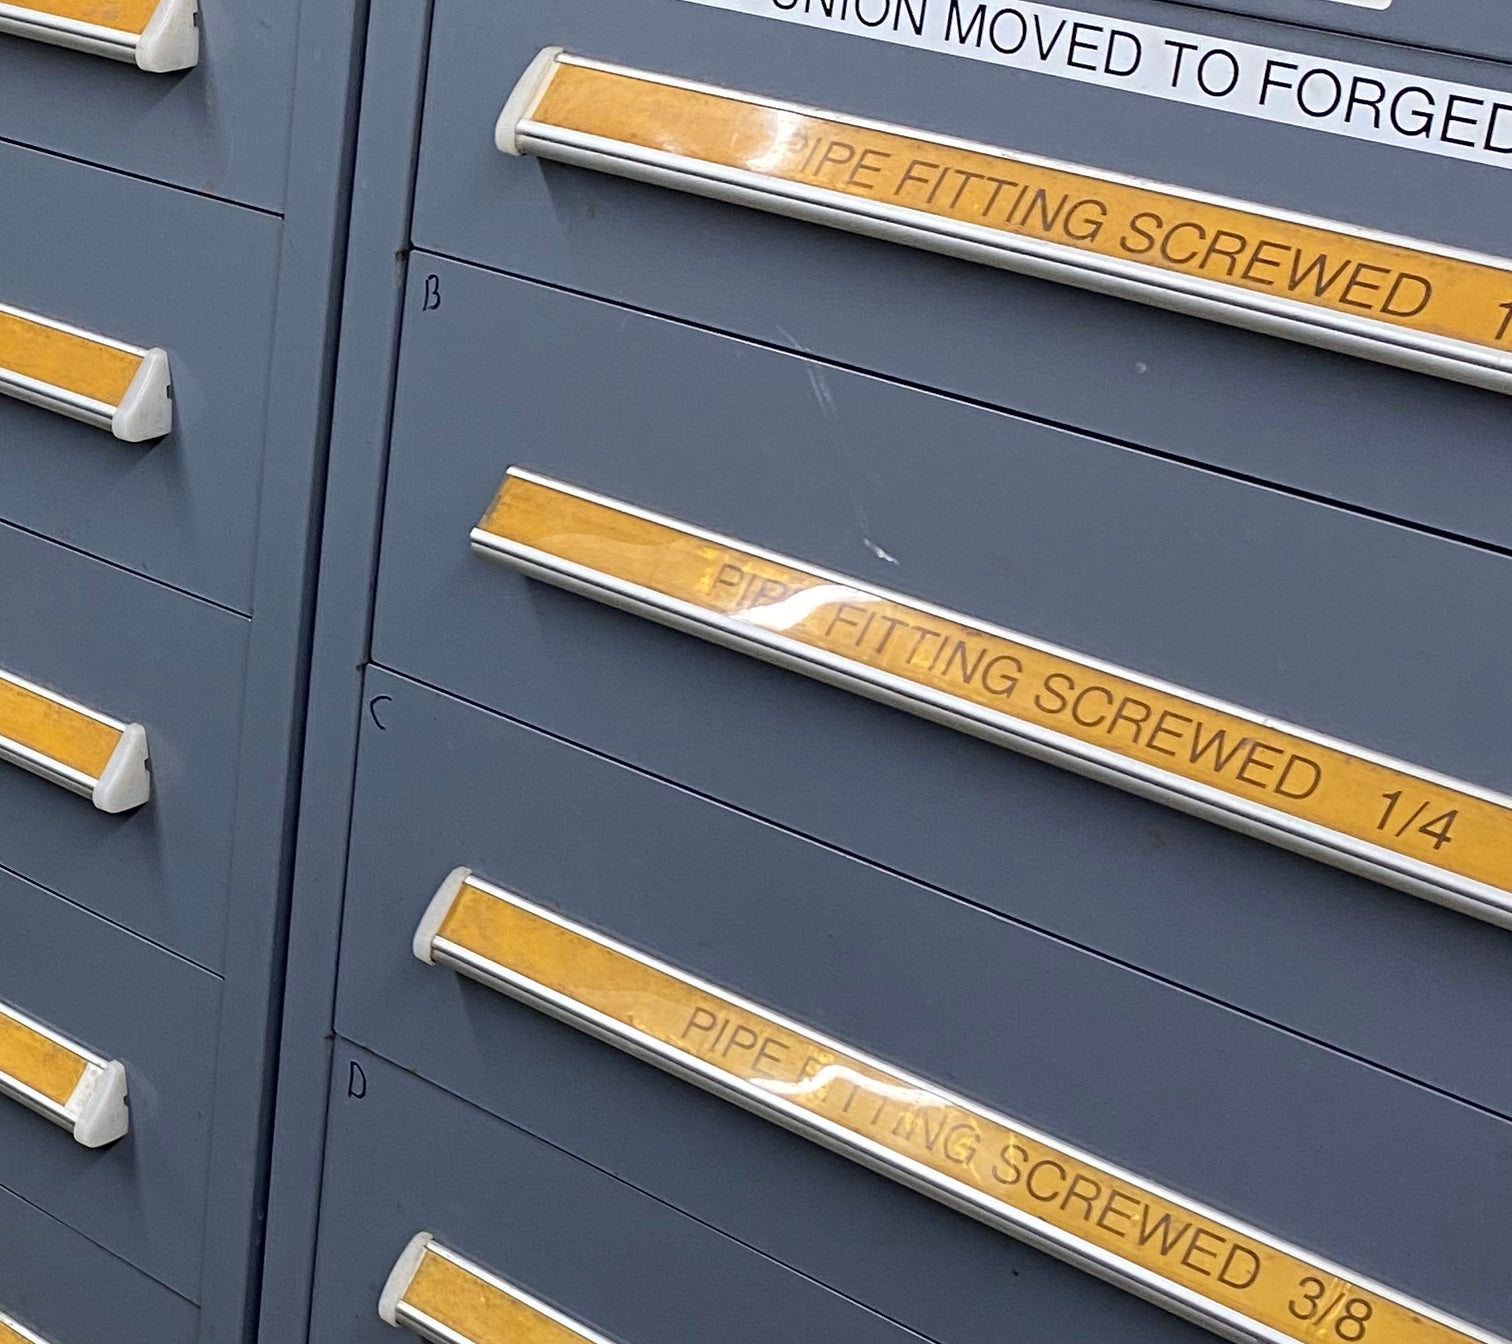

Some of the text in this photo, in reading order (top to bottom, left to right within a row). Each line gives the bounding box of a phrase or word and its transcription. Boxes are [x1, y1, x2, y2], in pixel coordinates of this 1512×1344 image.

[944, 1, 1142, 78] MOVED
[1165, 39, 1237, 99] TO
[893, 157, 1109, 245] FITTING
[1117, 211, 1434, 318] SCREWED
[422, 274, 441, 312] B
[369, 694, 392, 731] C
[708, 562, 1460, 852] PIP FITTING SCREWED 1/4
[346, 1059, 368, 1100] D
[681, 1006, 791, 1077] PIPE
[991, 1145, 1263, 1295] SCREWED
